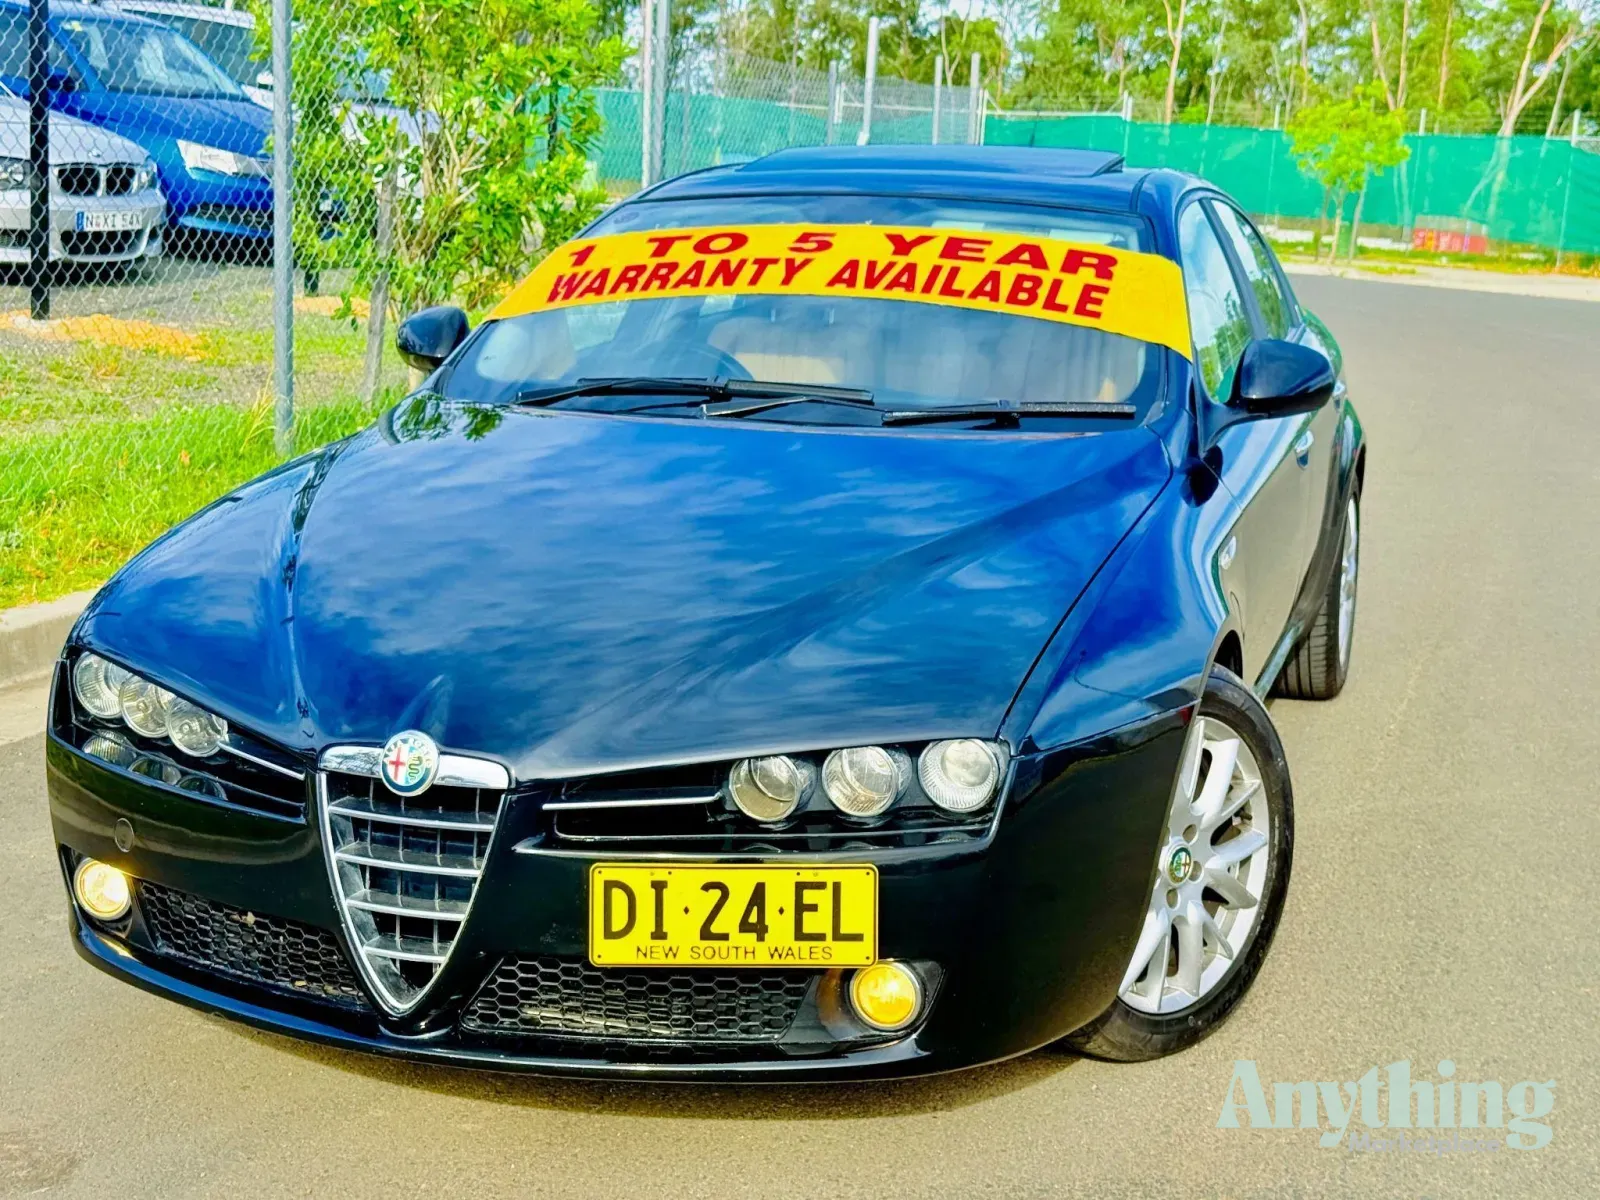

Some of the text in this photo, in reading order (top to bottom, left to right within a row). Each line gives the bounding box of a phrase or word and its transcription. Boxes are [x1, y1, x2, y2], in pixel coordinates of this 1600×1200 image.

[569, 232, 1119, 281] 1 TO 5 YEAR
[546, 257, 1111, 319] WARRANTY AVAILABLE
[636, 945, 833, 960] NEW SOUTH WALES
